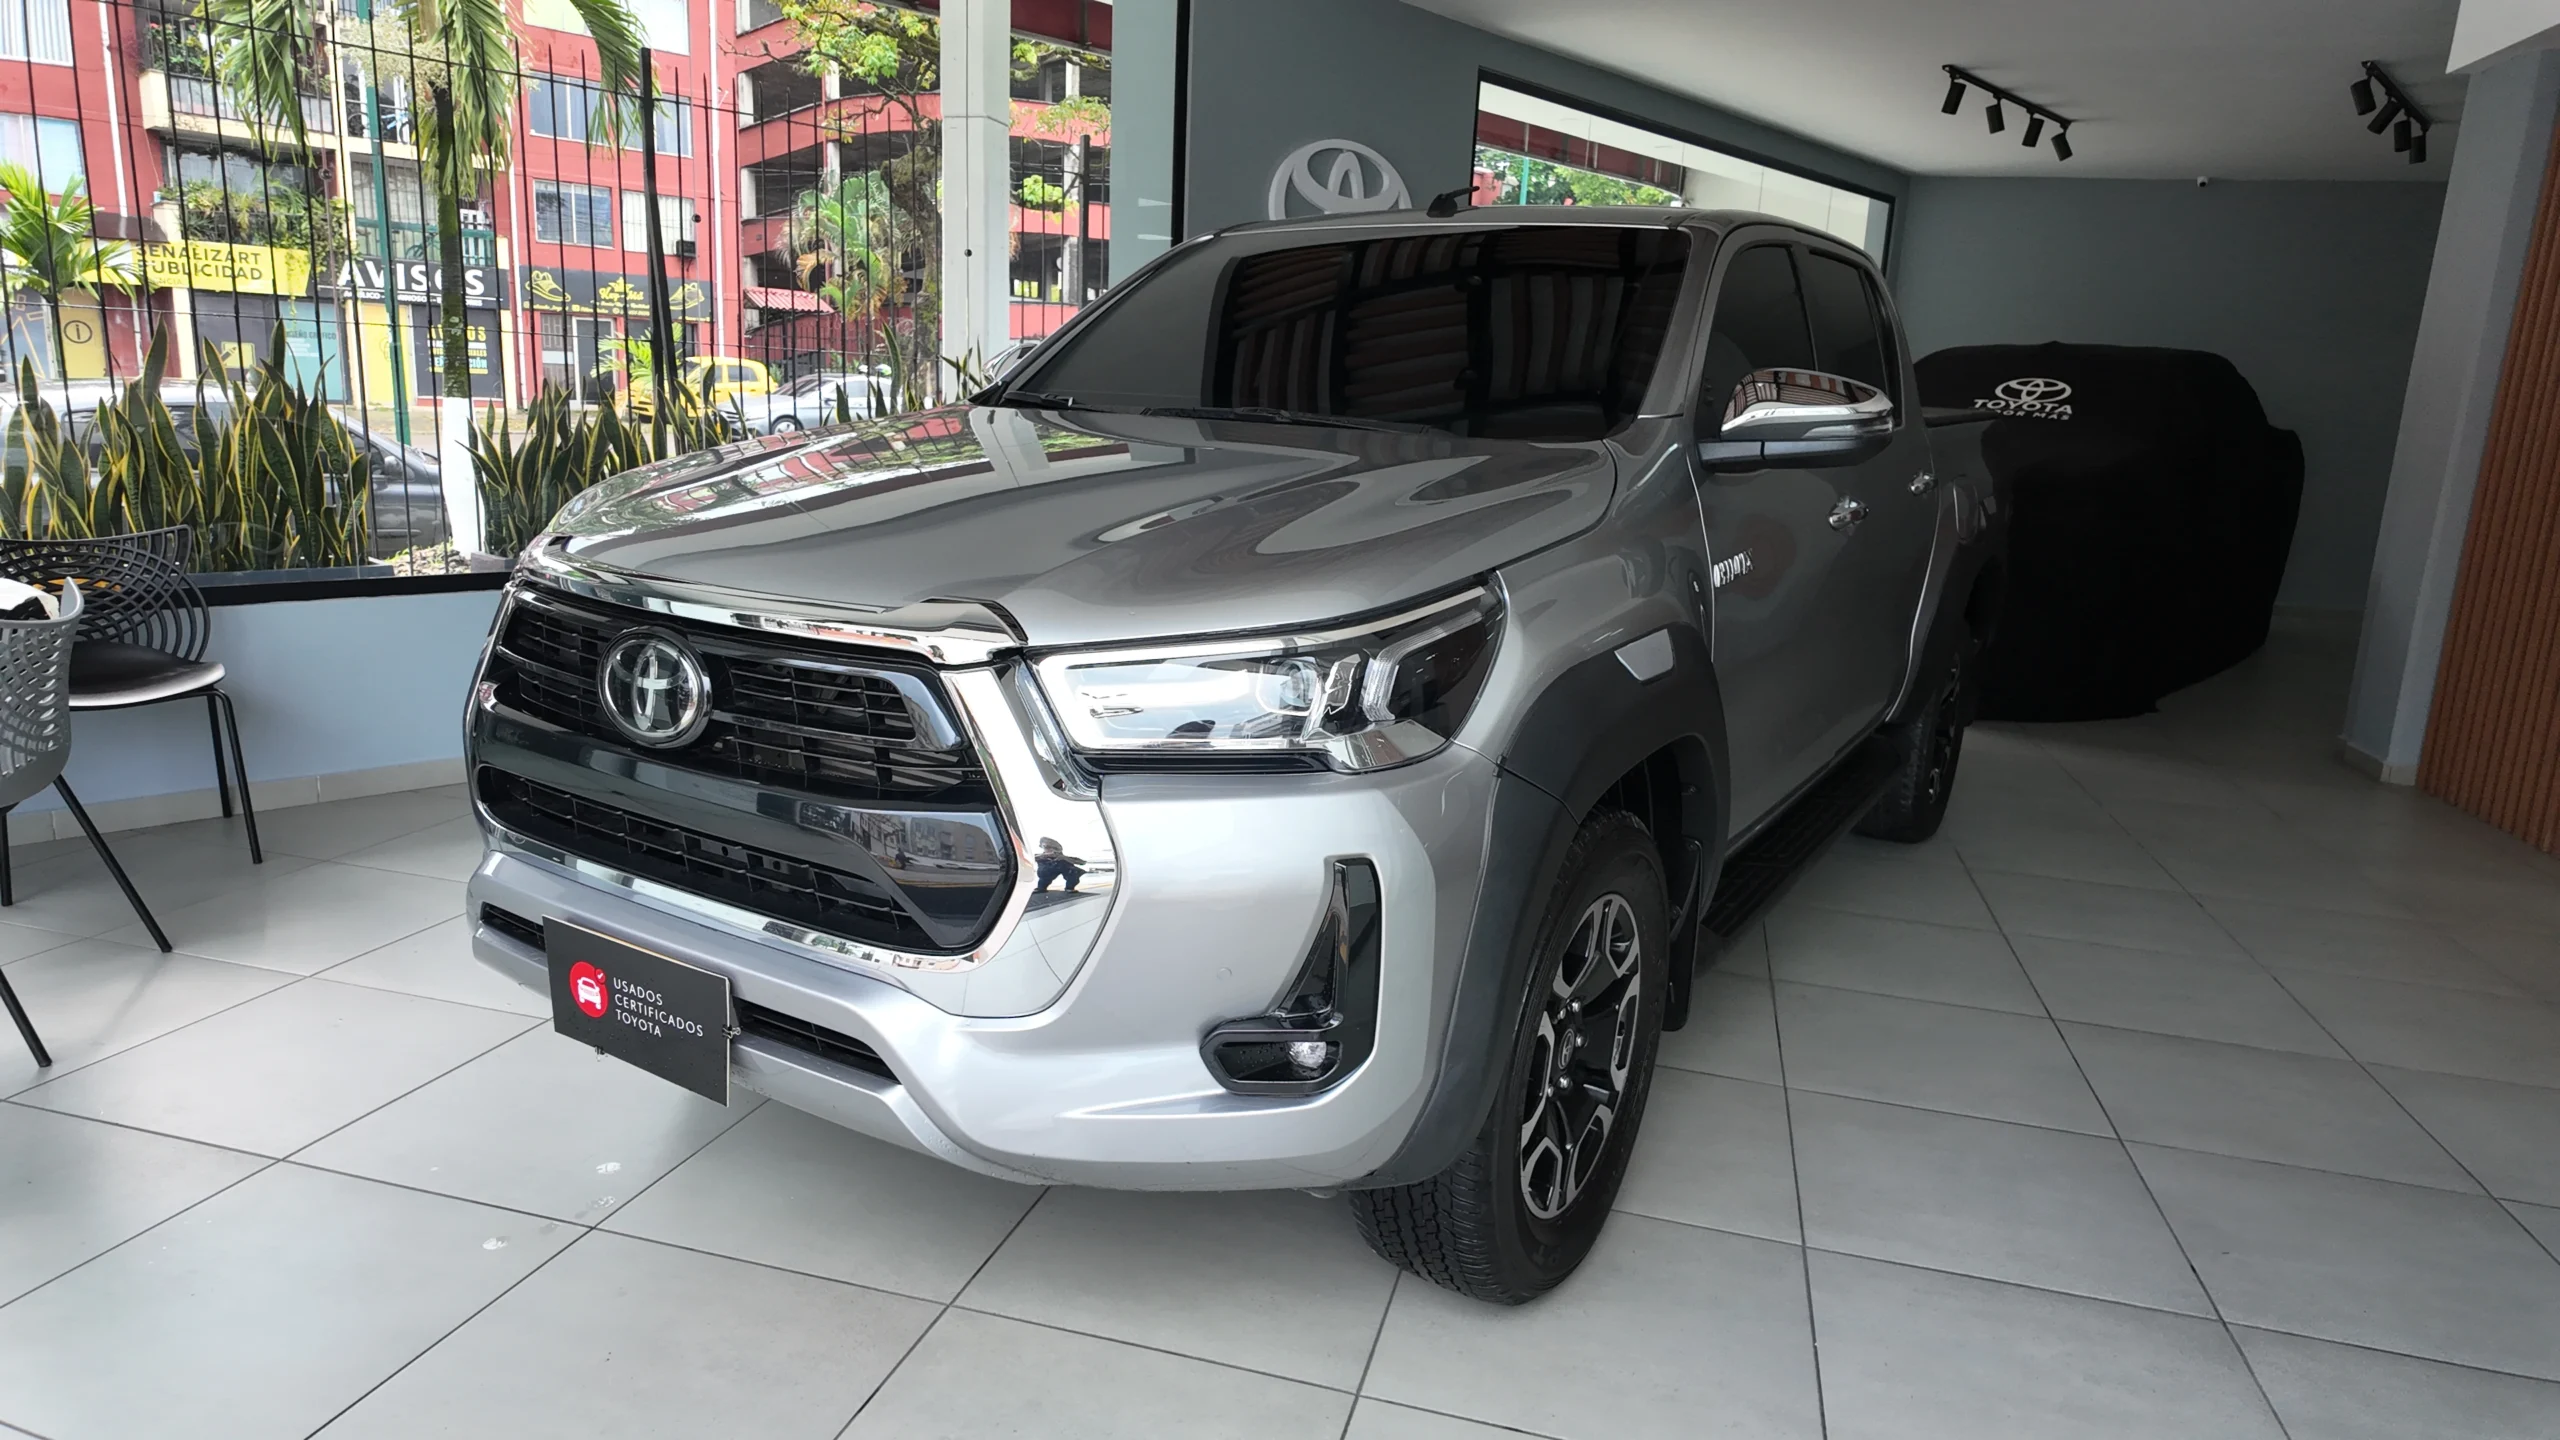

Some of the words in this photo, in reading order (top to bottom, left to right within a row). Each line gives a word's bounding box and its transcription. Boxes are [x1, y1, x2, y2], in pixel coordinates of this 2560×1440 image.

[336, 259, 485, 296] AVISS
[1973, 399, 2073, 414] TOYOTA
[613, 976, 663, 1006] USADOS
[614, 993, 704, 1037] CERTIFICADOS
[615, 1008, 662, 1038] TOYOTA
